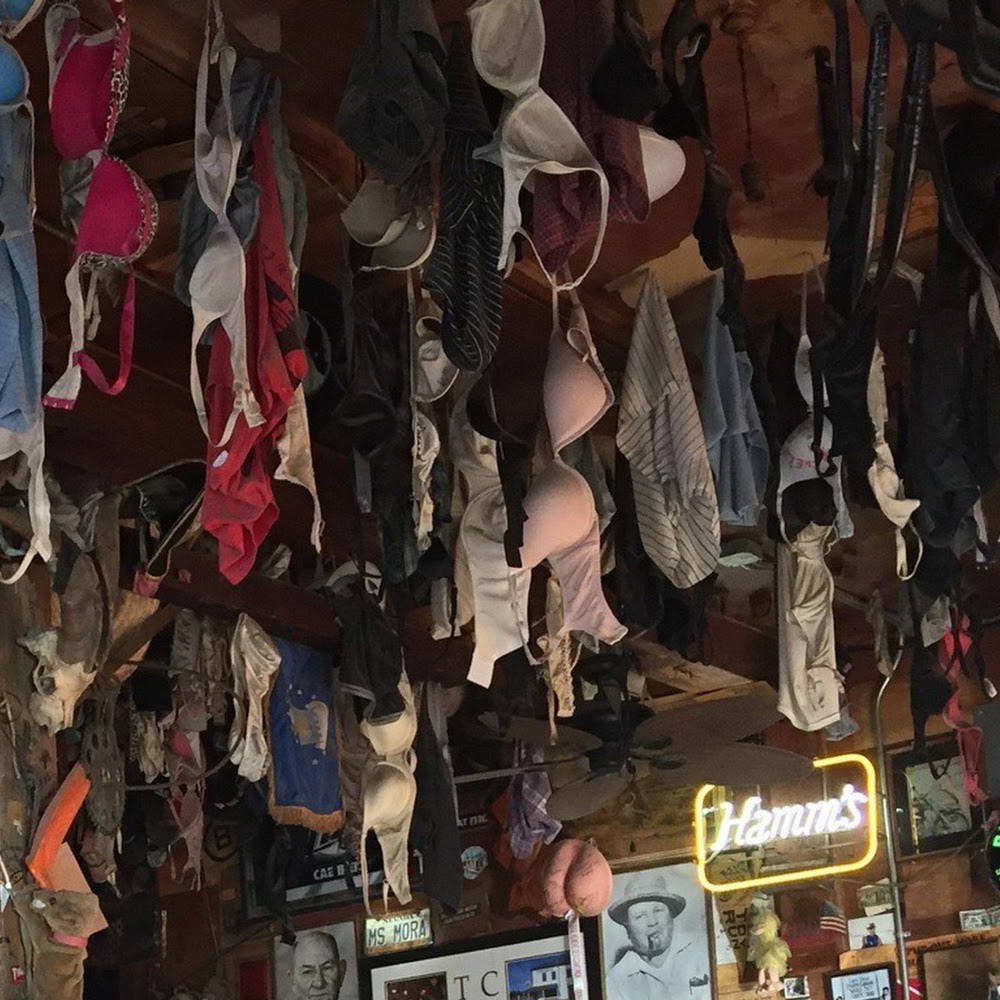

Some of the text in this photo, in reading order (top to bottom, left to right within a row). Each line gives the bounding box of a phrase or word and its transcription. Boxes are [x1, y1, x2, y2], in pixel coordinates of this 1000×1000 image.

[711, 784, 868, 851] Hamm's
[368, 918, 427, 946] MS MORA
[454, 971, 499, 1000] T C
